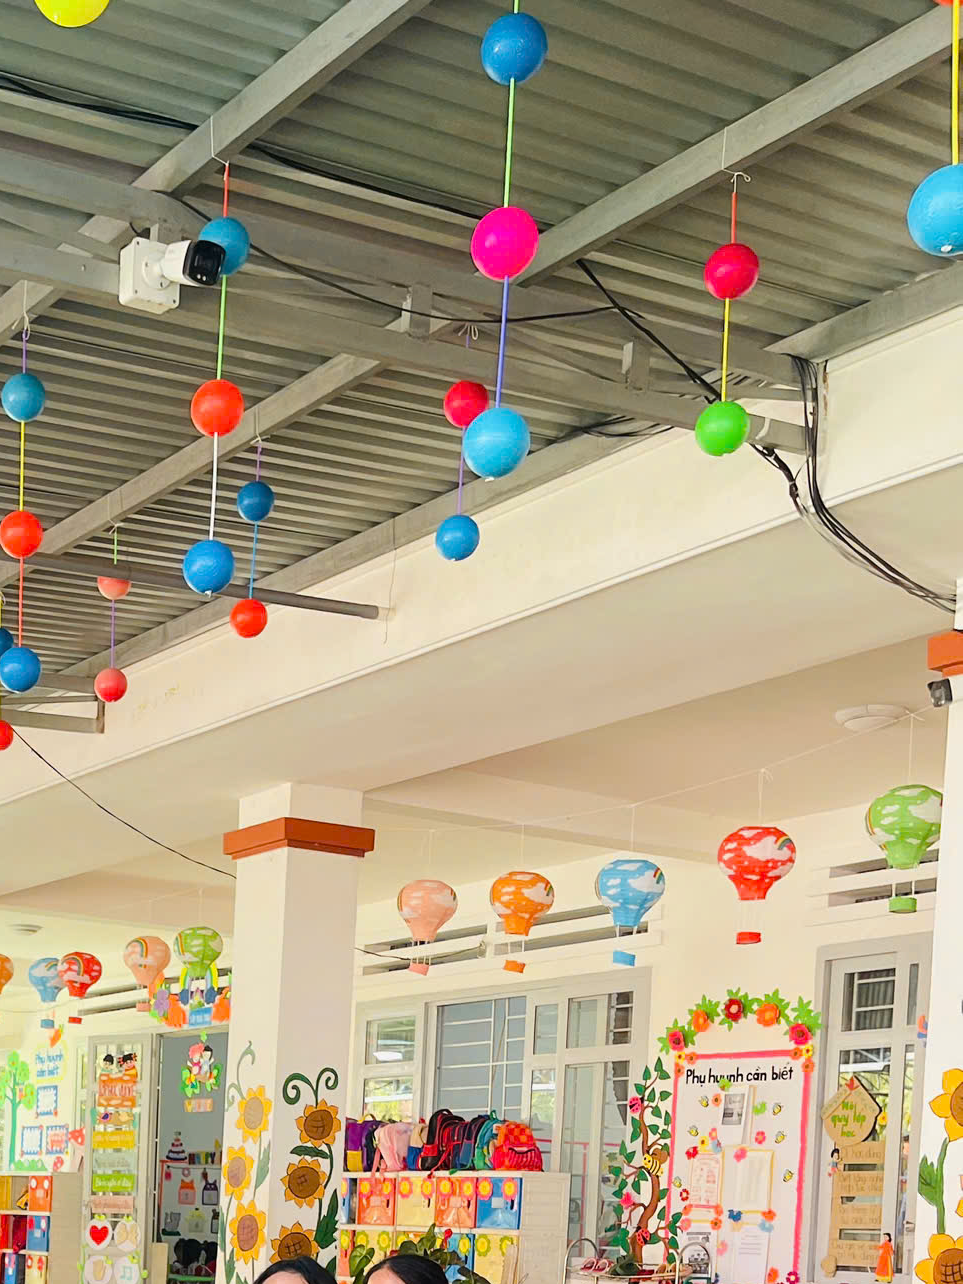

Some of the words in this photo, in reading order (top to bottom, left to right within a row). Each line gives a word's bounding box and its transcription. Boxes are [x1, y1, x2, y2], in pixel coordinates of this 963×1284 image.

[686, 1069, 705, 1087] Phụ
[746, 1066, 767, 1081] cần
[771, 1062, 793, 1080] biết
